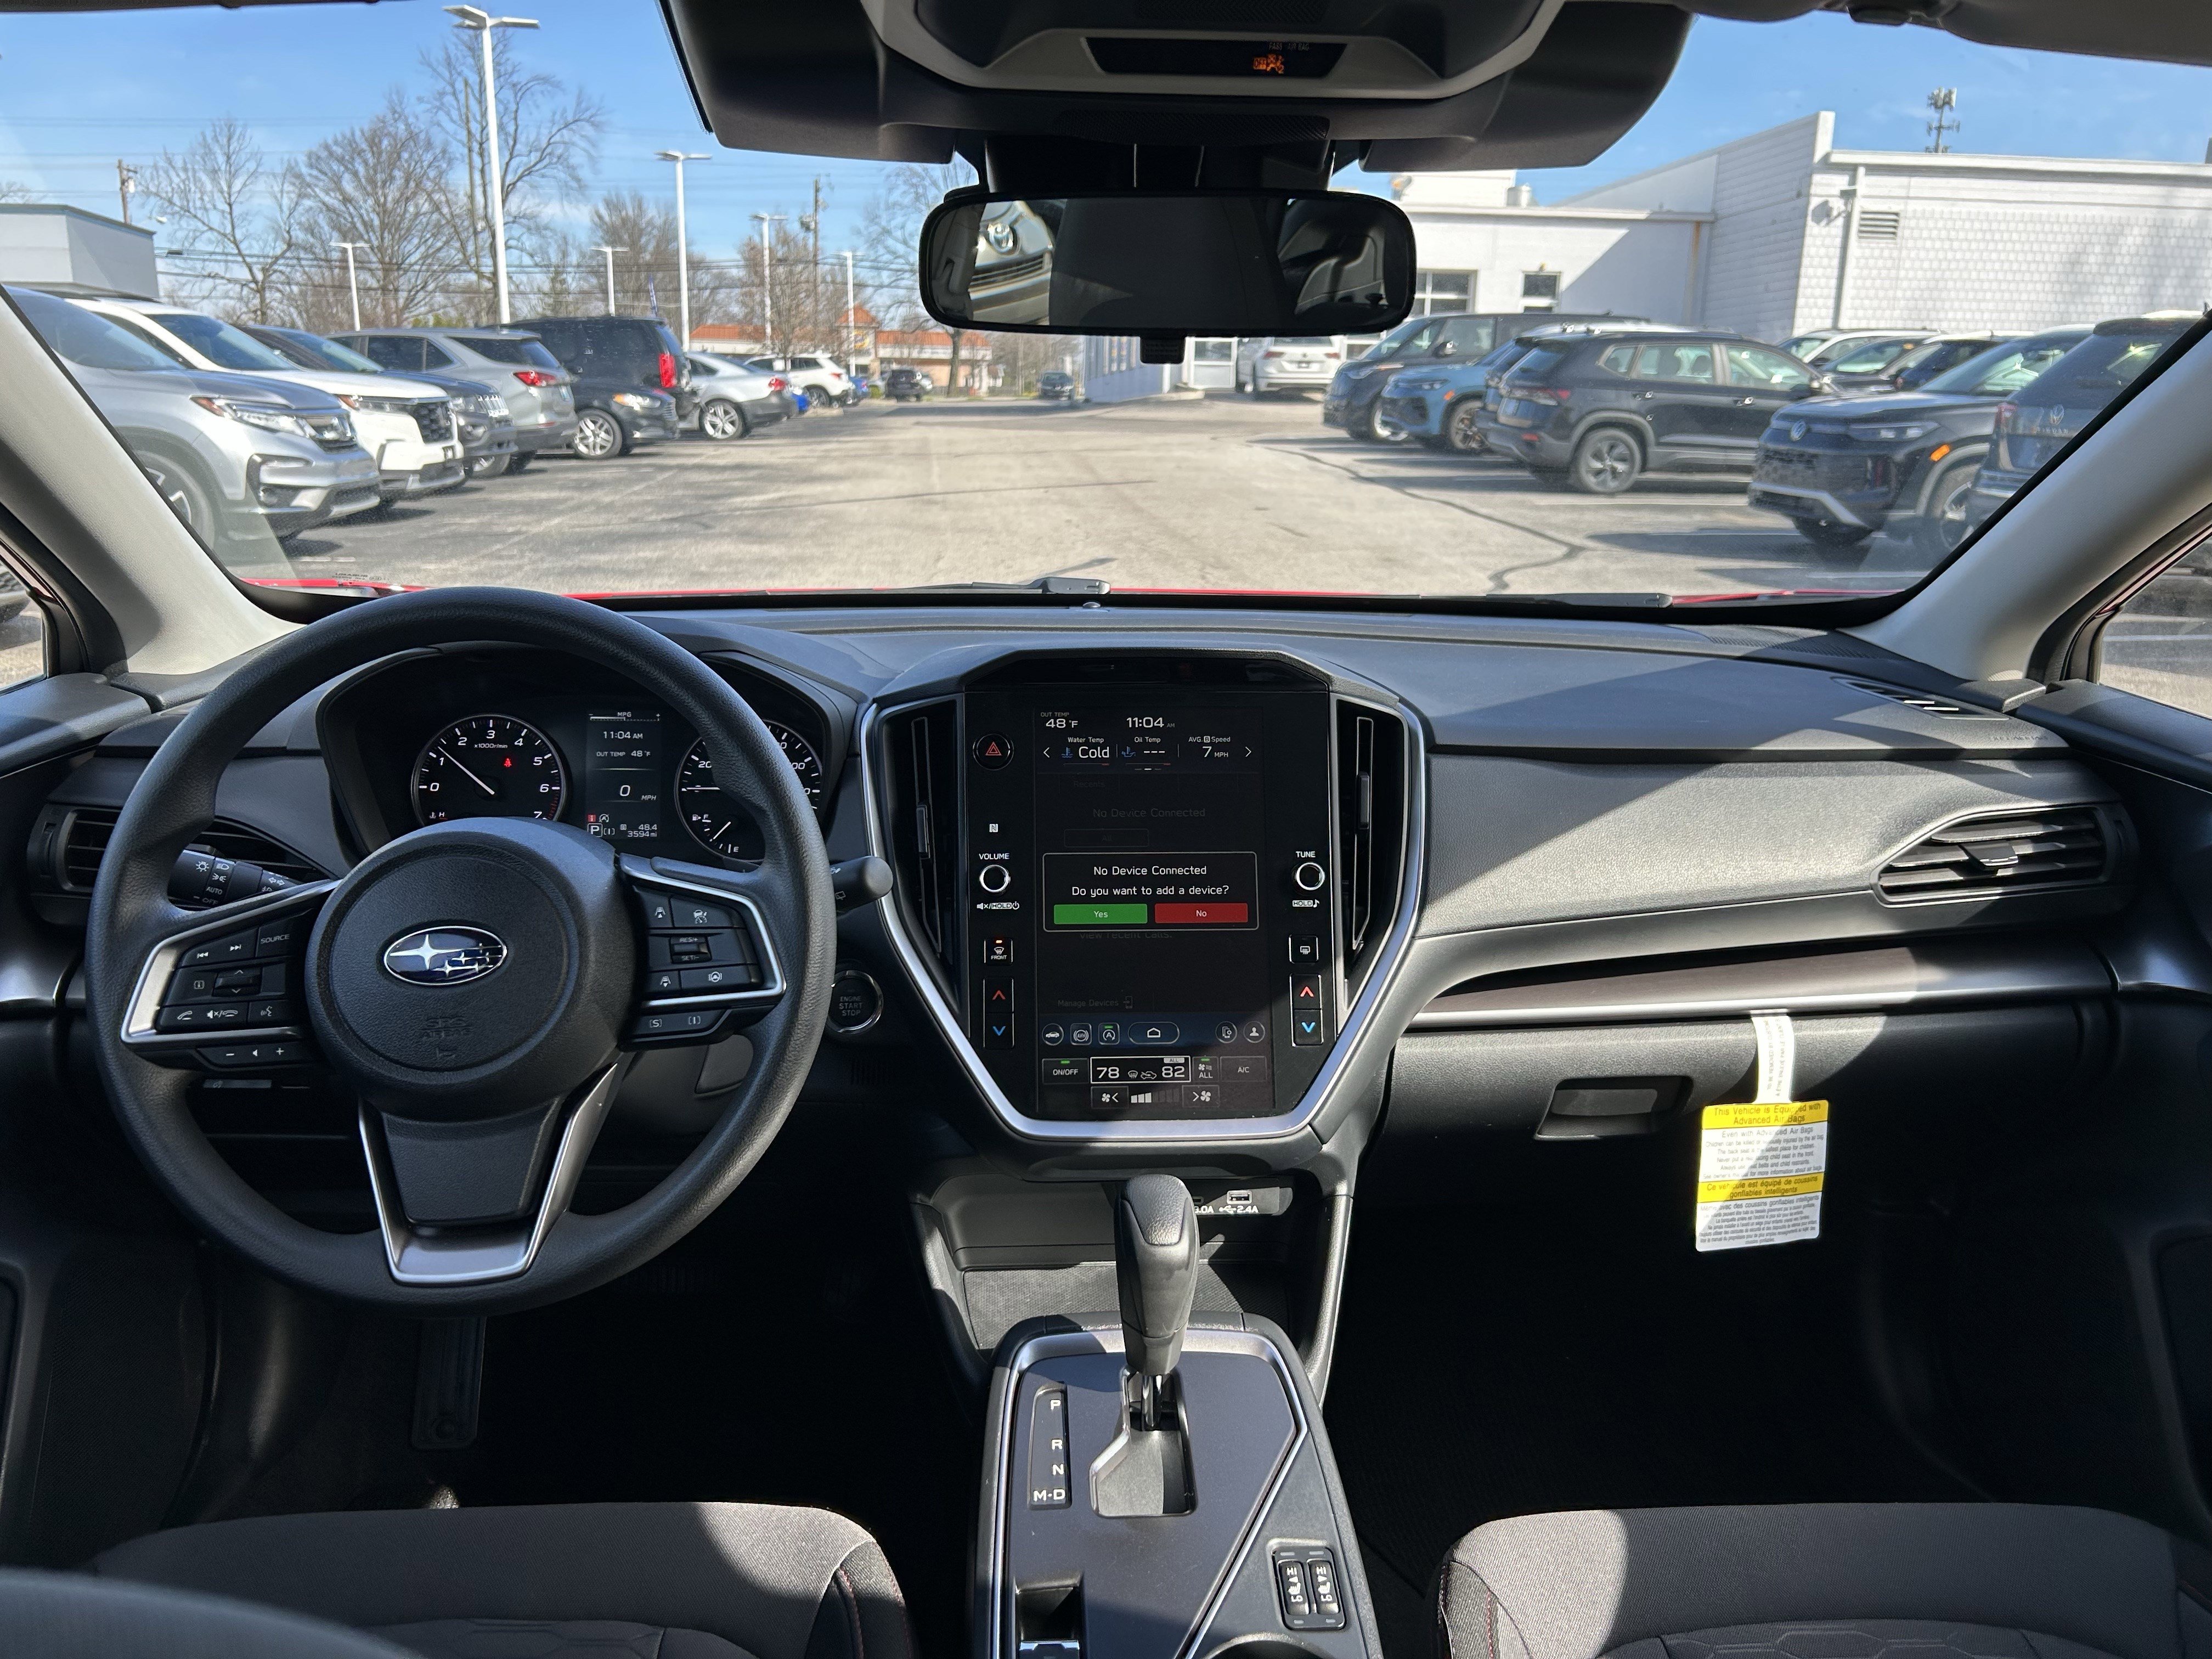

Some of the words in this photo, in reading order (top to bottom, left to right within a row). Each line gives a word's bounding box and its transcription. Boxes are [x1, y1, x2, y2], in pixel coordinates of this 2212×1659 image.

[1046, 719, 1066, 729] 48
[1126, 716, 1165, 729] 11:04
[486, 730, 495, 739] 3
[603, 731, 631, 739] 11:04
[458, 737, 467, 746] 2
[514, 738, 524, 747] 4
[1078, 746, 1109, 758] Cold
[1203, 746, 1212, 758] 7
[439, 757, 444, 766] 1
[533, 757, 544, 766] 5
[430, 782, 440, 792] 0
[540, 783, 550, 793] 6
[619, 785, 631, 797] 0
[534, 811, 543, 820] 7
[1093, 808, 1107, 817] No
[1111, 808, 1147, 817] Device
[1150, 807, 1206, 817] Connected
[1093, 866, 1108, 876] No
[1112, 866, 1148, 876] Device
[1152, 865, 1207, 876] Connected
[206, 887, 223, 895] AUTO
[1071, 886, 1086, 896] Do
[1090, 888, 1109, 898] you
[1113, 887, 1137, 895] want
[1141, 887, 1152, 895] to
[1156, 885, 1175, 895] add
[1188, 885, 1229, 895] device?
[202, 897, 219, 906] OFF
[1093, 910, 1108, 918] Yes
[261, 934, 290, 945] SOURCE
[1089, 998, 1119, 1007] Devices
[1096, 1066, 1120, 1079] 78
[1161, 1065, 1185, 1078] 82
[1713, 1107, 1729, 1116] This
[1733, 1106, 1761, 1115] Vehicle
[1734, 1115, 1771, 1125] Advanced
[1774, 1115, 1785, 1123] Air
[1787, 1114, 1805, 1123] Bags
[1236, 1205, 1259, 1214] 2.4A
[1050, 1399, 1062, 1411] P
[1052, 1438, 1063, 1451] R
[1052, 1463, 1064, 1476] N
[1286, 1567, 1297, 1576] HI
[1316, 1566, 1327, 1575] HI
